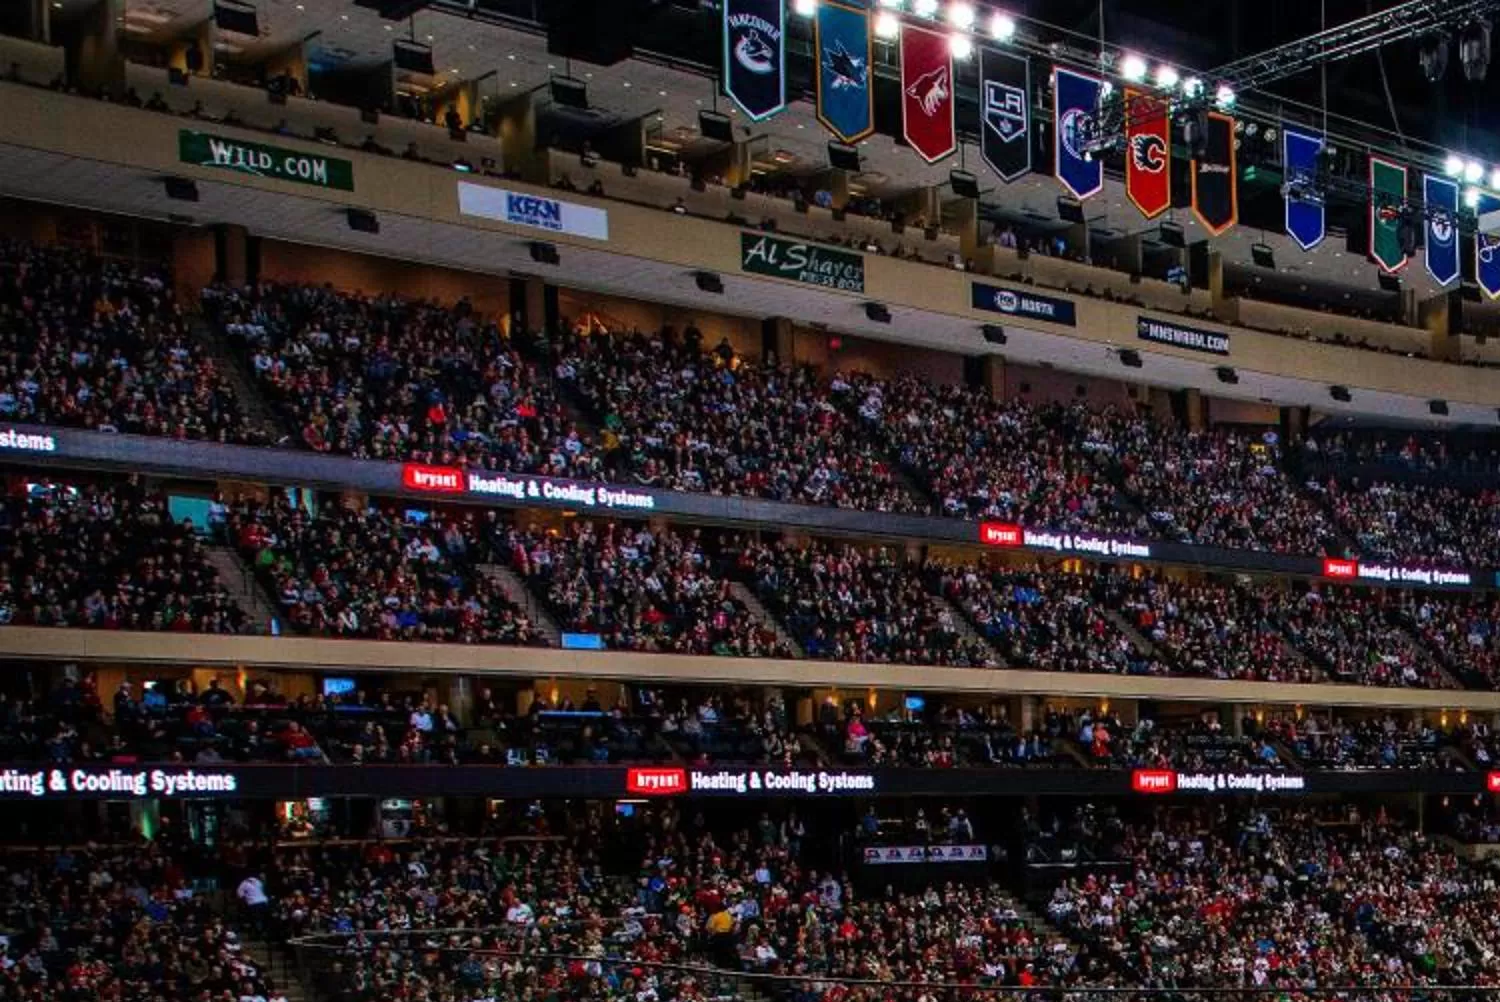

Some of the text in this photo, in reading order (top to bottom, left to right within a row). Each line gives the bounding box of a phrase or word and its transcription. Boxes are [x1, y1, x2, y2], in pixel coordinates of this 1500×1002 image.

[0, 428, 56, 451] stems
[413, 470, 654, 508] bryant Heating & Cooling Systems
[1023, 530, 1062, 550] Heating
[1074, 536, 1110, 555] Cooling
[1111, 540, 1150, 556] Systems
[1357, 563, 1390, 581] Heating
[1402, 568, 1432, 583] Cooling
[1433, 570, 1471, 585] Systems
[0, 769, 237, 795] ting & Cooling Systems
[637, 771, 875, 793] bryant Heating & Cooling Systems
[1177, 773, 1215, 791] Heating
[1228, 773, 1263, 791] Cooling
[1265, 773, 1305, 791] Systems
